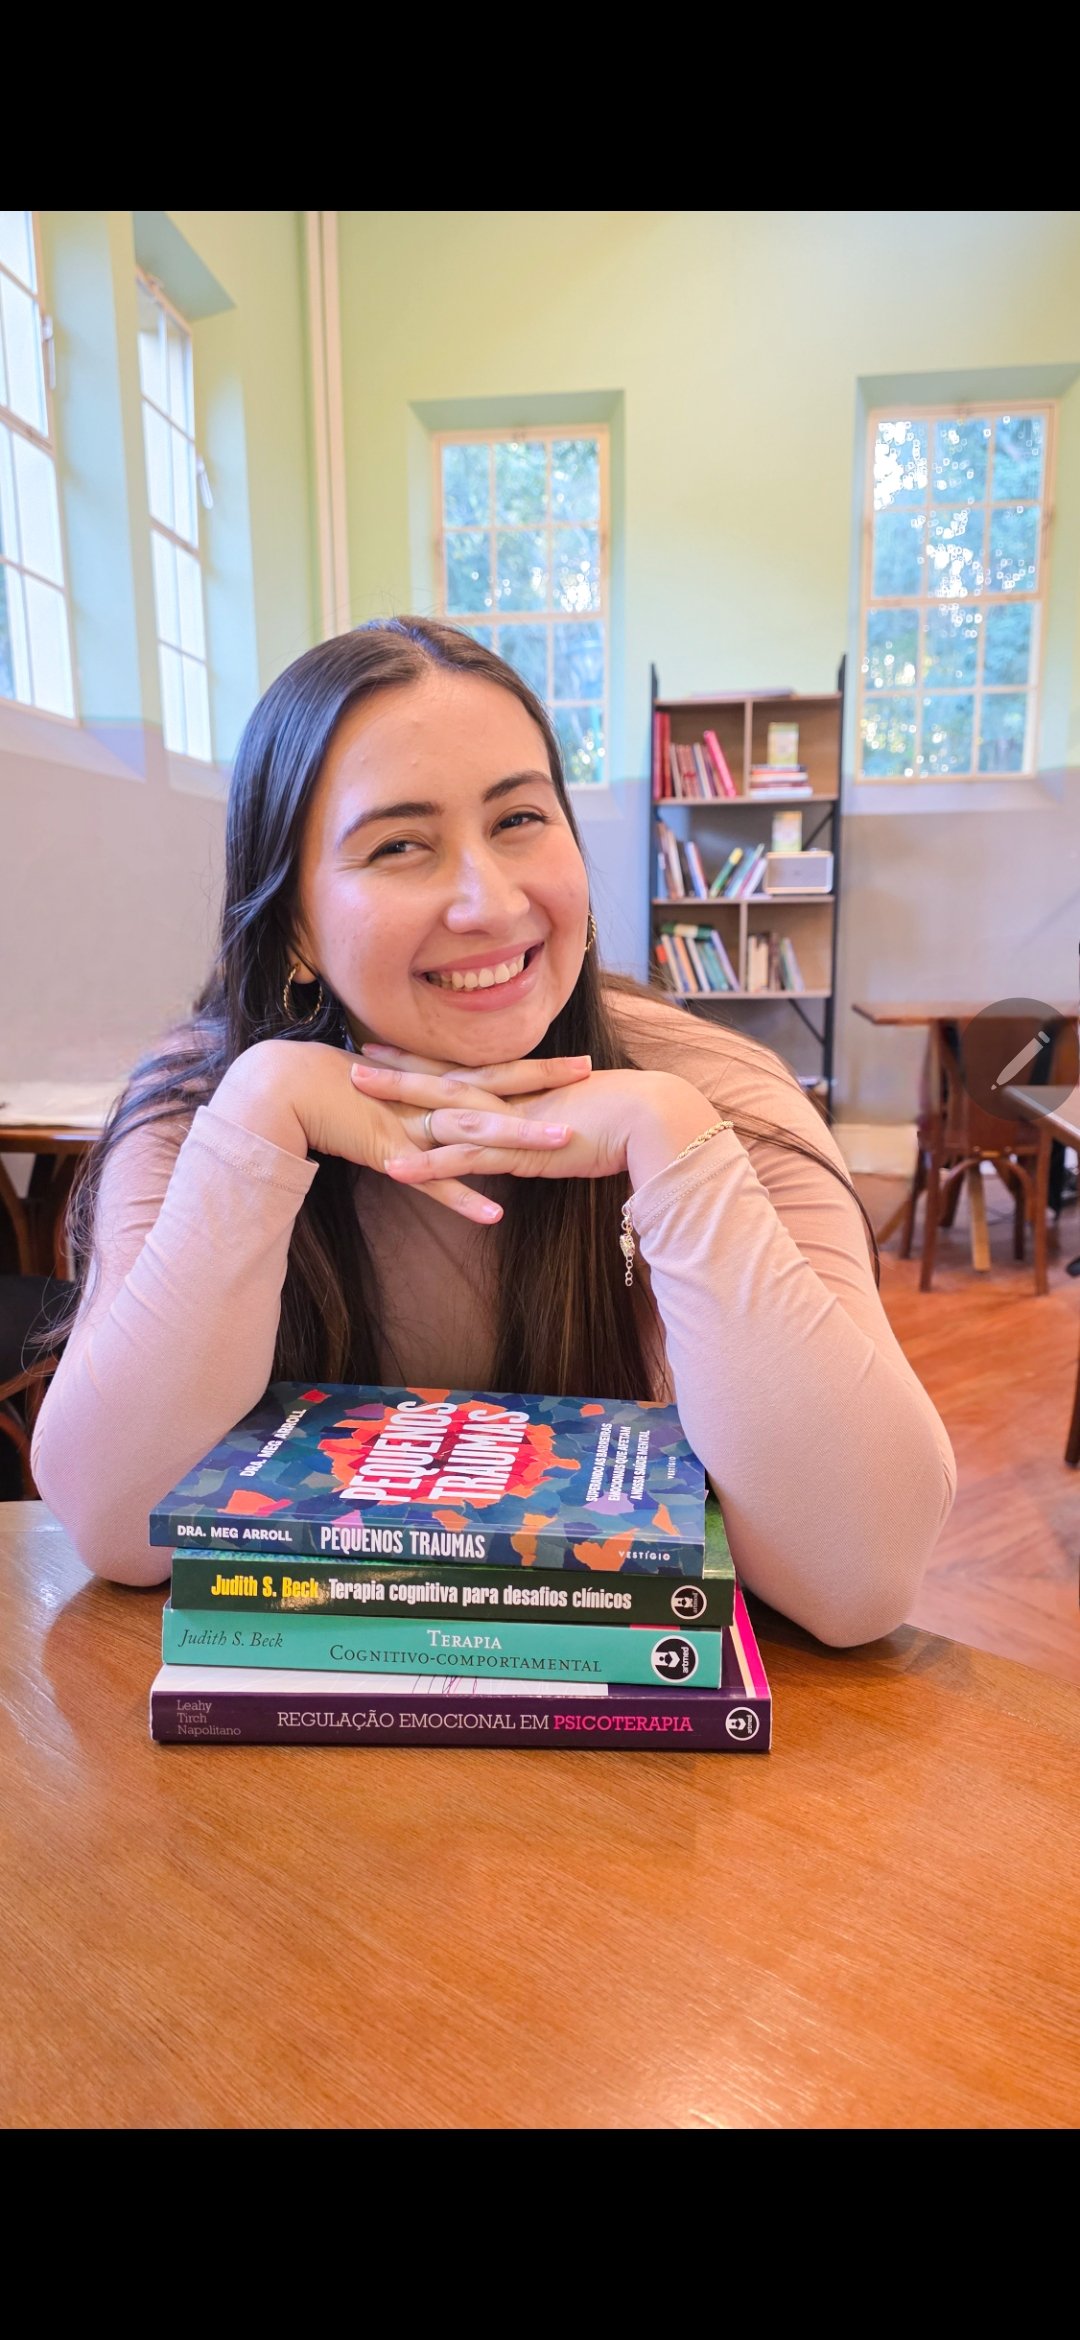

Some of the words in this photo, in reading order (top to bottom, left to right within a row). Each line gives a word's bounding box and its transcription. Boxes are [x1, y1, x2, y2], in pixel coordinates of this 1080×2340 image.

[240, 1459, 267, 1477] DRA.
[256, 1440, 283, 1458] MEG
[274, 1409, 307, 1439] ARROLL
[617, 1426, 631, 1451] AFETAM
[637, 1430, 650, 1455] MENTAL
[339, 1401, 458, 1503] PEQUENOS
[428, 1409, 530, 1500] TRAUMAS
[586, 1466, 604, 1501] SUPERANDO
[596, 1423, 612, 1457] BARREIRAS
[615, 1451, 629, 1464] QUE
[632, 1455, 647, 1475] SAÚDE
[608, 1464, 625, 1500] EMOCIONAIS
[631, 1475, 645, 1494] NOSSA
[177, 1525, 206, 1537] DRA.
[211, 1526, 239, 1539] MEG
[243, 1528, 293, 1541] ARROLL
[320, 1526, 403, 1555] PEQUENOS
[409, 1531, 486, 1559] TRAUMAS
[618, 1550, 670, 1562] VESTÍGIO
[211, 1574, 258, 1597] Judith
[262, 1576, 277, 1597] S.
[282, 1577, 319, 1599] Beck
[329, 1578, 385, 1604] Terapia
[389, 1581, 458, 1605] cognitiva
[462, 1587, 499, 1607] para
[503, 1583, 568, 1608] desafios
[572, 1586, 632, 1610] clínicos
[178, 1629, 227, 1648] Judith
[232, 1631, 245, 1647] S.
[250, 1631, 283, 1648] Beck
[427, 1629, 502, 1650] TERAPIA
[681, 1646, 690, 1674] artmed
[176, 1700, 213, 1714] Leahy
[177, 1713, 208, 1724] Tirch
[177, 1724, 242, 1737] Napolitano
[277, 1709, 395, 1731] REGULAÇÃO
[399, 1713, 517, 1730] EMOCIONAL
[520, 1714, 550, 1731] EM
[553, 1715, 694, 1732] PSICOTERAPIA
